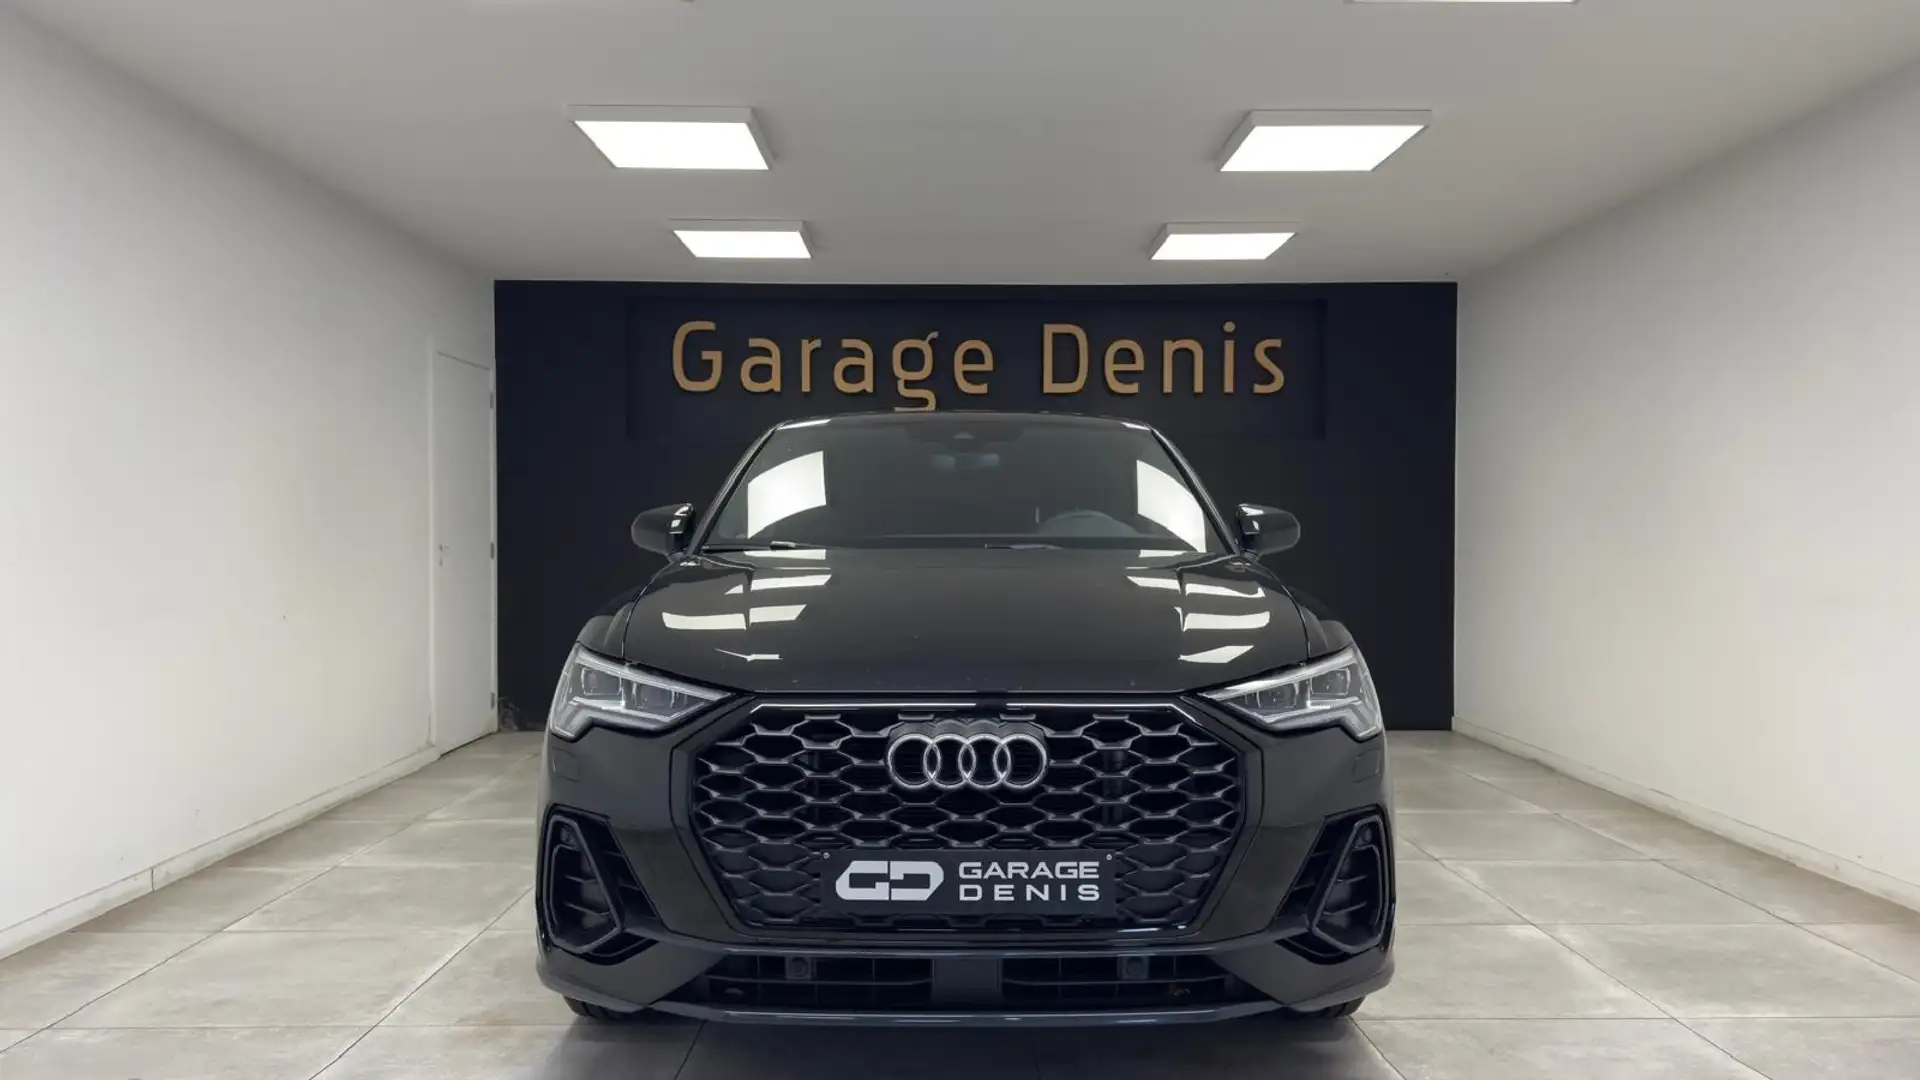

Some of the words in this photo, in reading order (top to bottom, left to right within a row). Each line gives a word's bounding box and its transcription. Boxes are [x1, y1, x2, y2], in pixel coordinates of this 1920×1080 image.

[672, 320, 994, 412] Garage
[1042, 321, 1286, 394] Denis
[958, 861, 1100, 880] GARAGE
[958, 884, 1101, 901] DENIS
